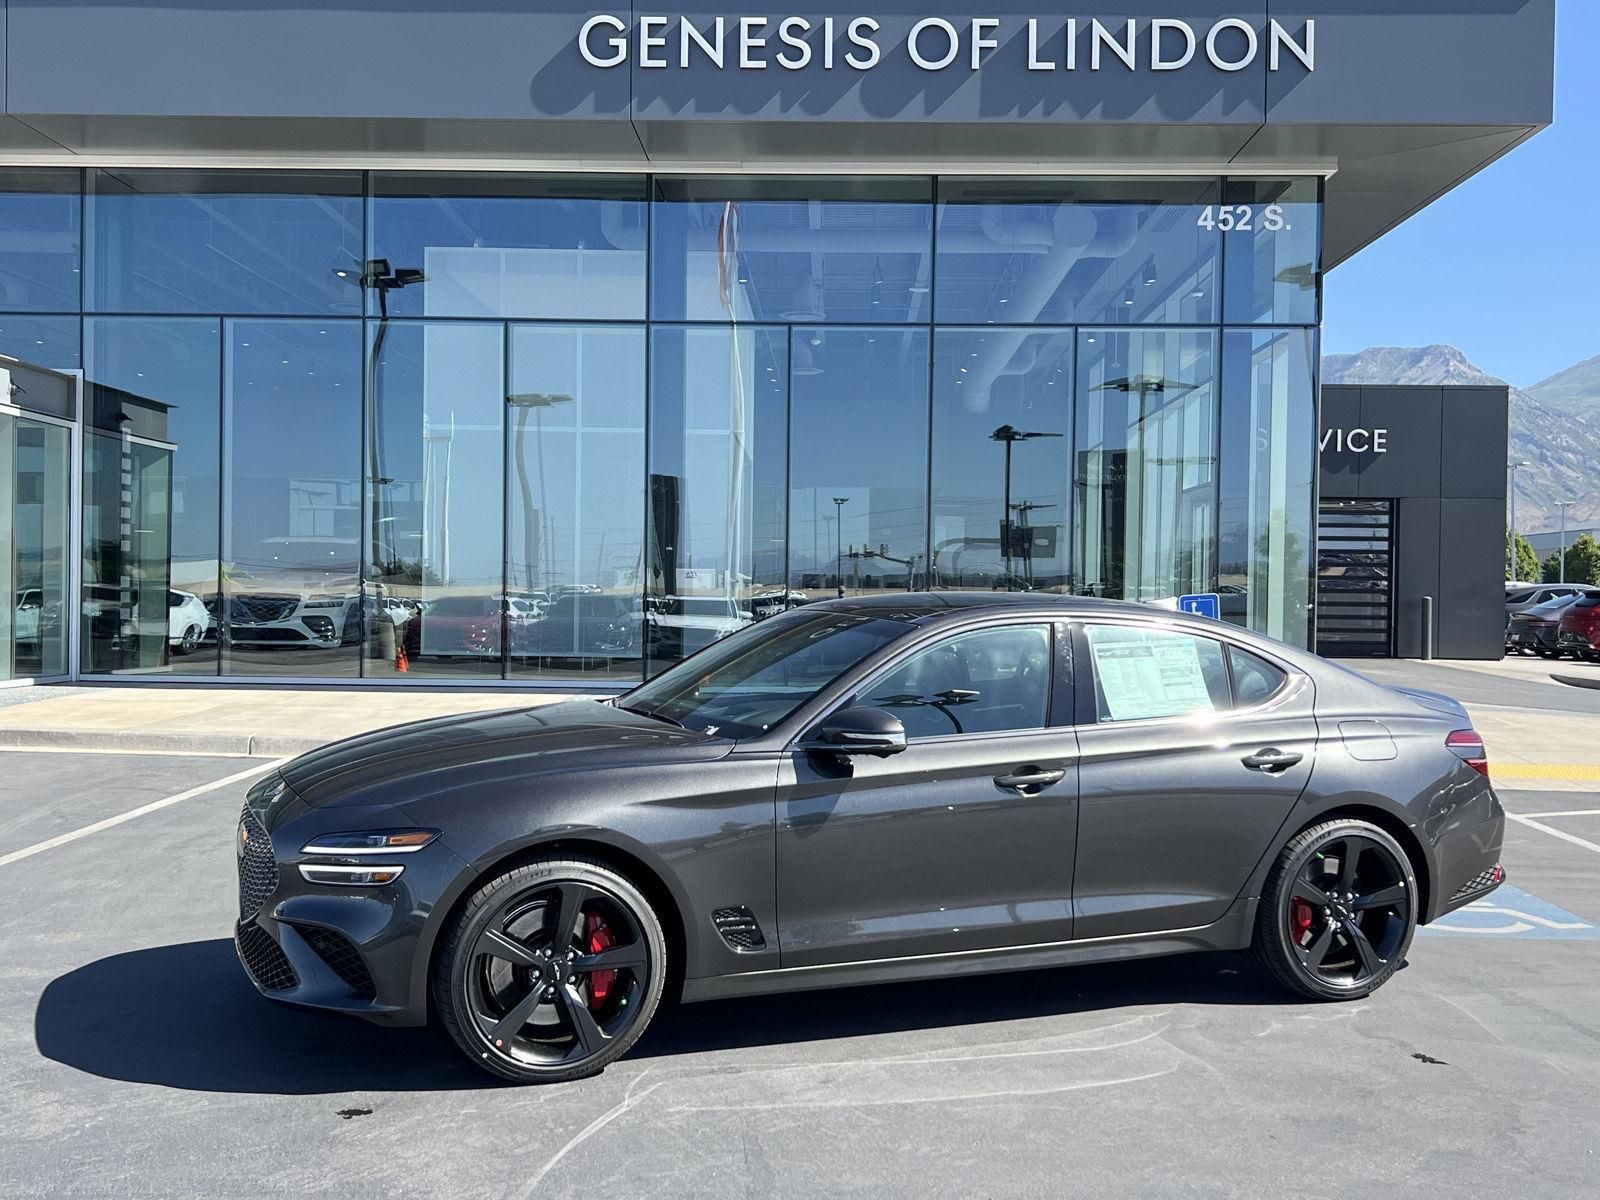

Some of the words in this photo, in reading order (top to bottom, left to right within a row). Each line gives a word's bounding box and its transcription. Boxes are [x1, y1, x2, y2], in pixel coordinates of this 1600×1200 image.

[578, 15, 880, 70] GENESIS
[907, 17, 999, 71] OF
[1027, 18, 1314, 72] LINDON
[1197, 205, 1252, 231] 452
[1263, 205, 1292, 231] S.
